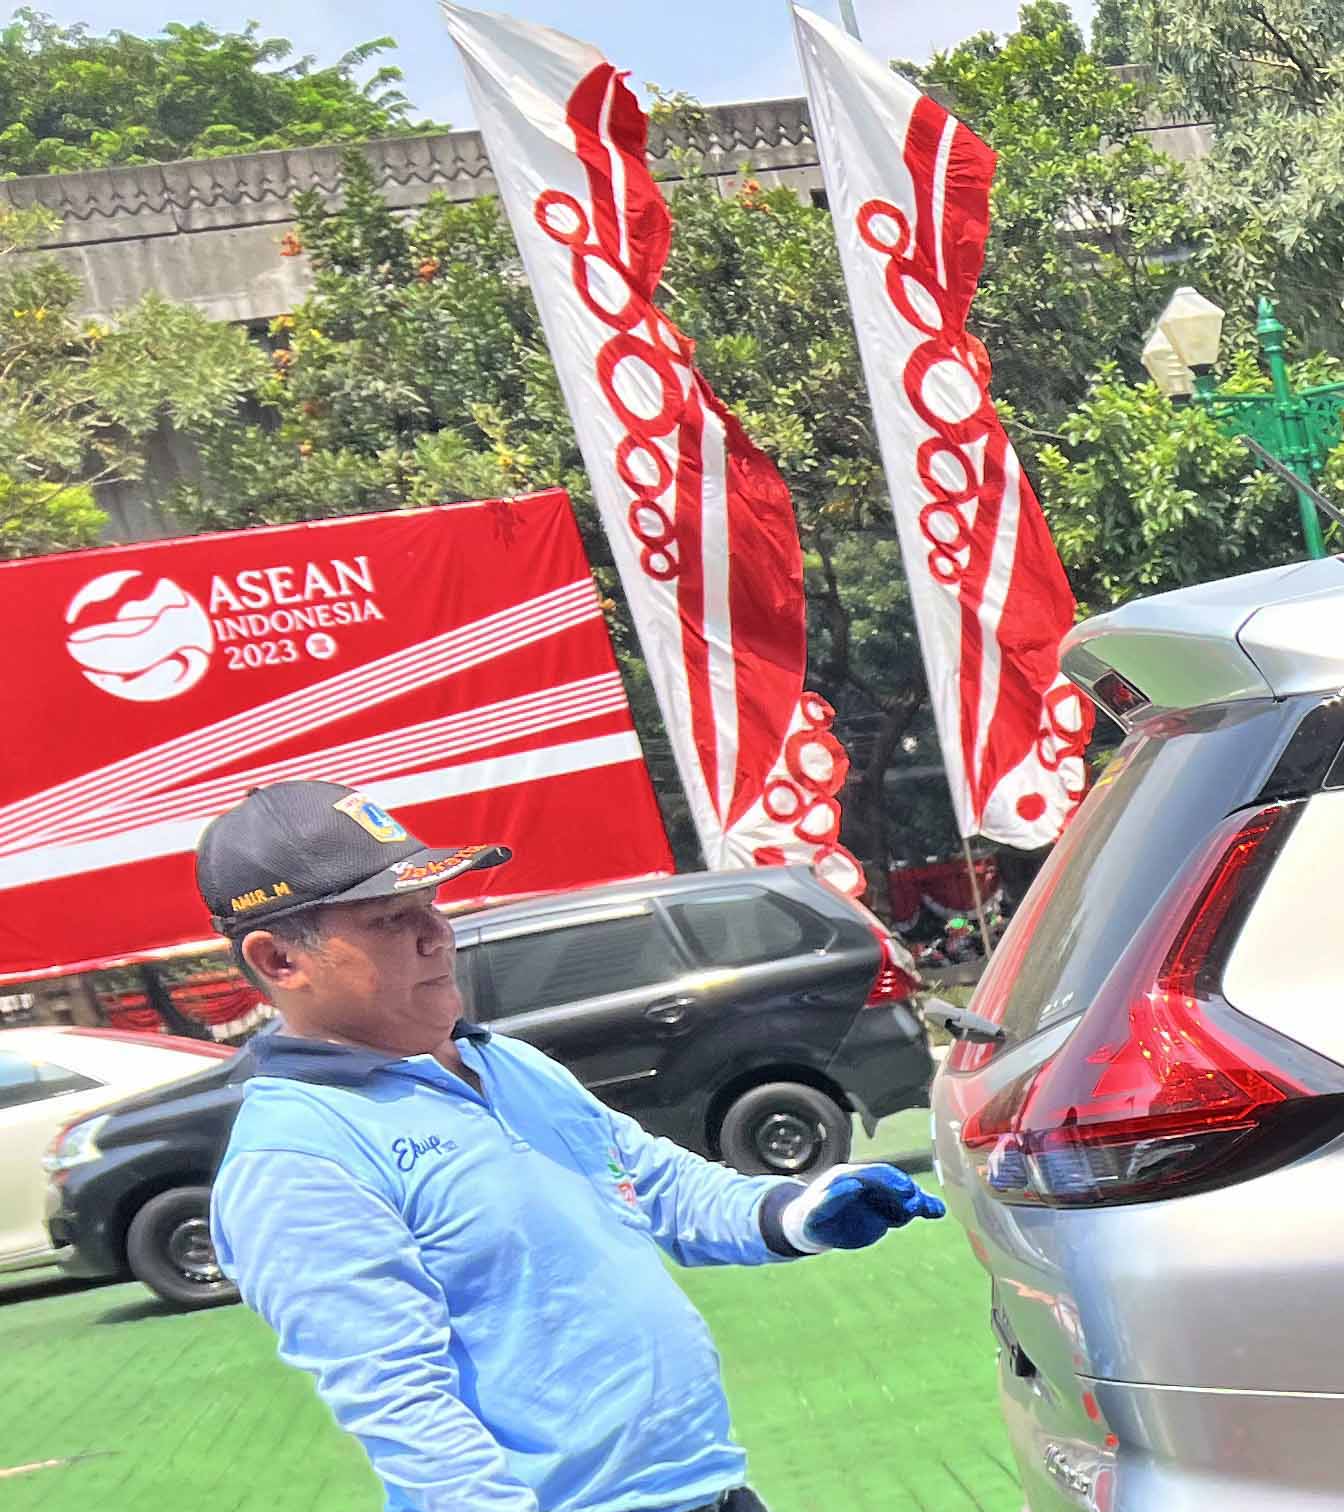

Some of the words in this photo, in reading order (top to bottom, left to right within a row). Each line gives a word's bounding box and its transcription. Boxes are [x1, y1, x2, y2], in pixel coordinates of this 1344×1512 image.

[209, 555, 375, 614] ASEAN
[213, 599, 385, 641] INDONESIA
[224, 639, 300, 671] 2023
